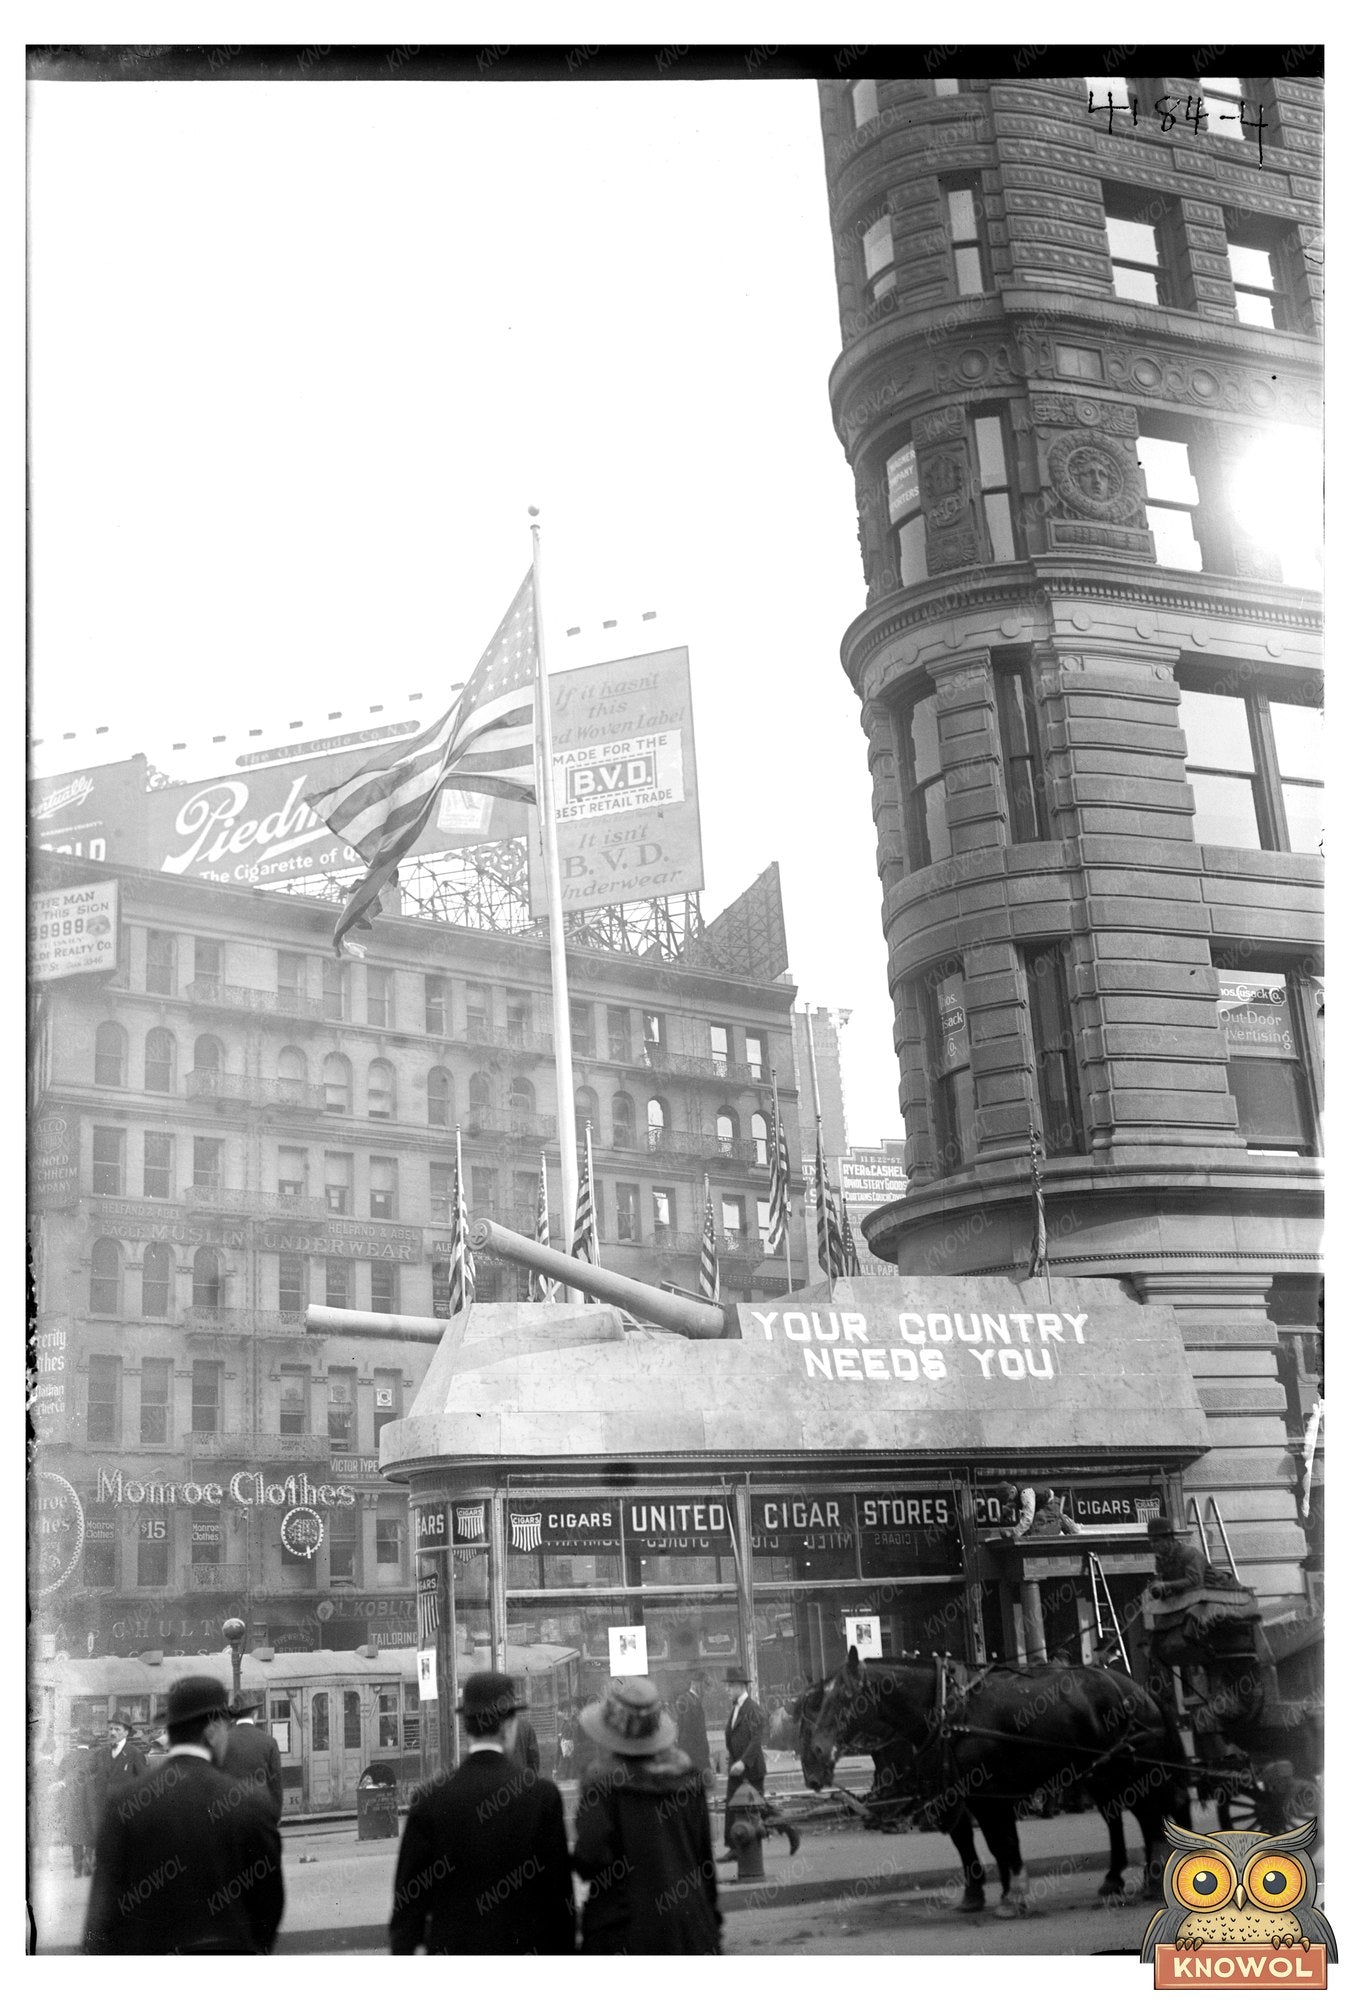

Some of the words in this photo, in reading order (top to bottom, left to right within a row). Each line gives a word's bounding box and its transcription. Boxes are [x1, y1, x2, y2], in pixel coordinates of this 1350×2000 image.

[581, 684, 595, 700] it
[589, 699, 628, 718] this
[577, 719, 634, 741] Woven
[636, 706, 686, 730] Label
[553, 747, 597, 766] MADE
[602, 742, 631, 758] FOR
[635, 734, 668, 751] THE
[573, 761, 653, 796] B.V.D.
[555, 803, 586, 820] BEST
[589, 796, 634, 813] RETAIL
[636, 788, 673, 803] TRADE
[579, 832, 598, 849] It
[603, 824, 649, 844] isn't
[199, 870, 231, 883] The
[233, 851, 313, 881] Cigarette
[320, 851, 338, 864] of
[63, 892, 95, 905] MAN
[54, 943, 94, 958] REALTY
[1219, 1008, 1283, 1026] Out-Door
[151, 1223, 245, 1247] MUSLIN
[327, 1225, 376, 1238] HELFAND
[390, 1230, 418, 1242] ABEL
[263, 1236, 412, 1261] UNDERWEAR
[751, 1311, 870, 1343] YOUR
[898, 1312, 1090, 1346] COUNTRY
[803, 1348, 949, 1381] NEEDS
[967, 1348, 1055, 1381] YOU
[330, 1459, 358, 1473] VICTOR
[97, 1467, 223, 1505] Monroe
[228, 1471, 355, 1505] Clothes
[458, 1509, 484, 1517] CIGARS
[512, 1516, 541, 1525] CIGARS
[548, 1512, 613, 1529] CIGARS
[631, 1504, 726, 1532] UNITED
[764, 1501, 841, 1529] CIGAR
[863, 1499, 948, 1526] STORES
[1077, 1499, 1132, 1515] CIGARS
[86, 1521, 115, 1532] Monroe
[86, 1531, 115, 1541] Clothes
[140, 1519, 166, 1541] $15
[192, 1522, 220, 1533] Monroe
[191, 1532, 220, 1542] Clothes
